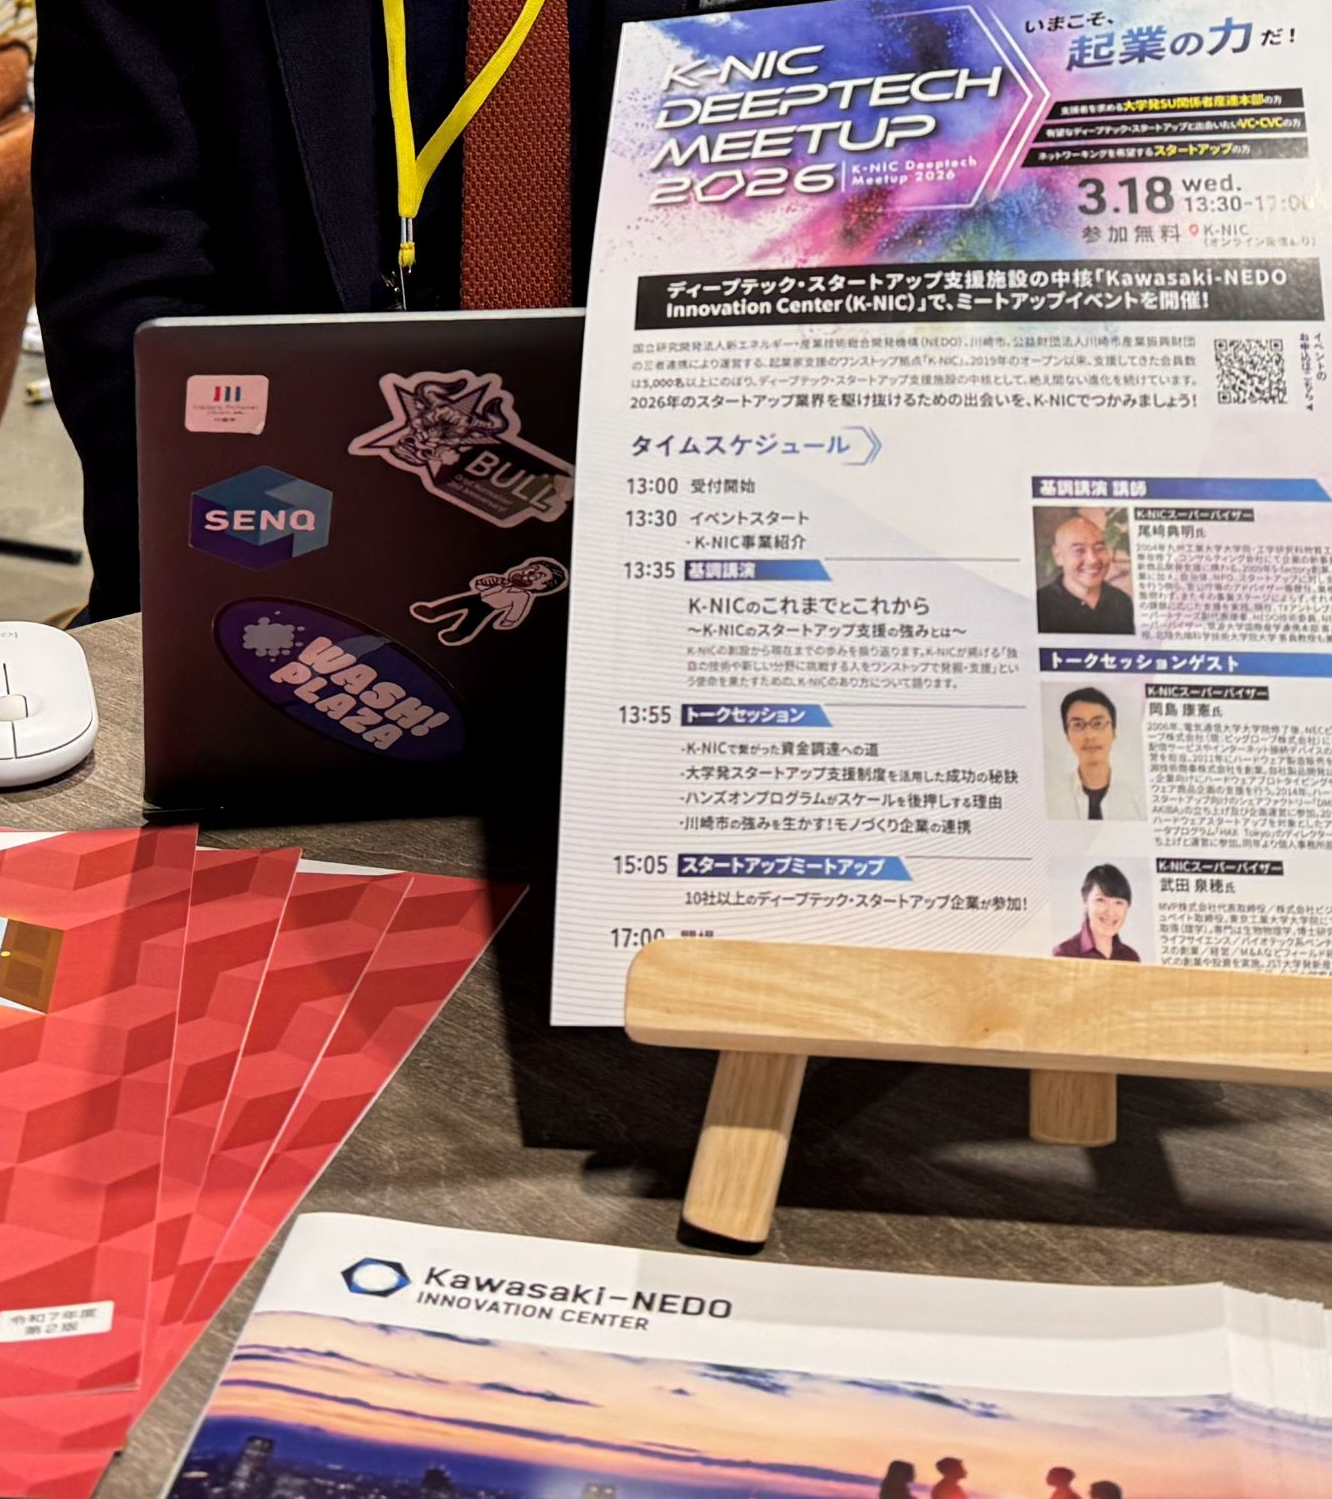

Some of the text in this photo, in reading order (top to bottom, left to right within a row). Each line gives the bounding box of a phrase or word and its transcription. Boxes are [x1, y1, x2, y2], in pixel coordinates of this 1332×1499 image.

[1026, 11, 1115, 33] いまこそ、
[662, 45, 824, 91] K-NIC
[655, 66, 1003, 129] DEEPTECH
[651, 114, 936, 170] MEETUP
[852, 155, 976, 174] K-NIC Deeptech
[650, 163, 837, 205] 2026
[852, 170, 955, 186] Meetup 2026
[1078, 174, 1242, 215] 3.18 wed.
[1082, 224, 1181, 244] 参加無料
[1204, 224, 1249, 236] K-NIC
[667, 298, 772, 318] Innovation
[631, 433, 851, 458] タイムスケジュール
[464, 450, 555, 510] BULL
[627, 477, 756, 494] 13:00 受付開始
[203, 508, 317, 534] SENQ
[626, 510, 810, 527] 13:30 イベントスタート
[624, 562, 675, 579] 13:35
[688, 596, 930, 615] K-NICのこれまでとこれから
[1050, 652, 1240, 672] トークセッションゲスト
[297, 636, 451, 738] WASH!
[1147, 686, 1268, 698] K-NICスーパーバイザー
[269, 660, 404, 751] PLAZA
[619, 706, 806, 724] 13:55 トークセッション
[613, 856, 885, 877] 15:05 スタートアップミートアップ
[1158, 859, 1283, 874] K-NICスーパーバイザー
[1160, 878, 1189, 893] 武田
[423, 1265, 733, 1320] Kawasaki-NEDO
[416, 1289, 650, 1332] INNOVATION CENTER
